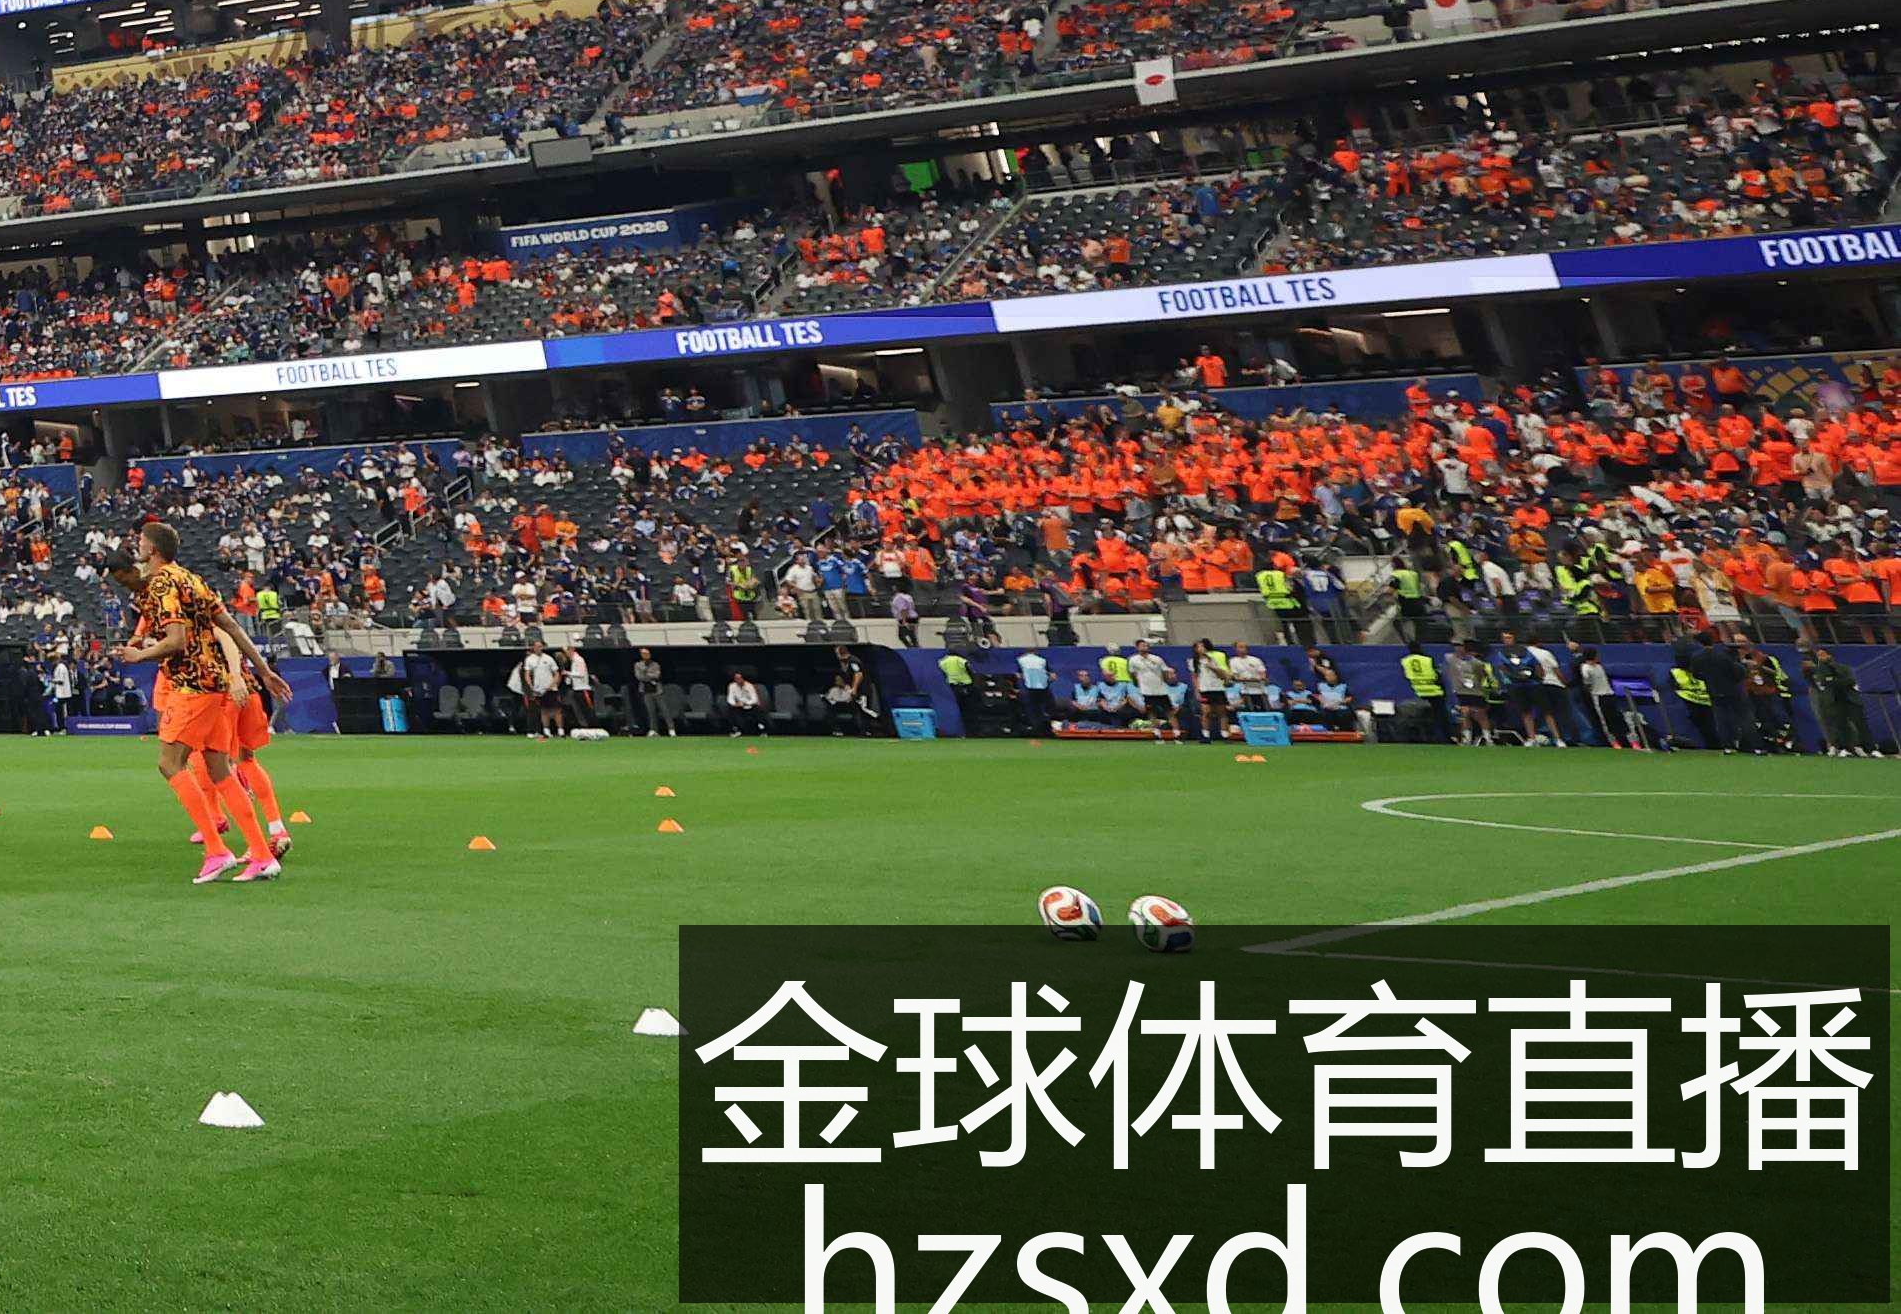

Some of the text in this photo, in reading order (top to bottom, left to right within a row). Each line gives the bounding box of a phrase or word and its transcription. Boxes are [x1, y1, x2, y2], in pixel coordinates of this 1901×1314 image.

[511, 220, 669, 247] FIFA WORLD CUP 2026
[1757, 230, 1901, 268] FOOTBAL
[1159, 278, 1336, 314] FOOTBALL TES
